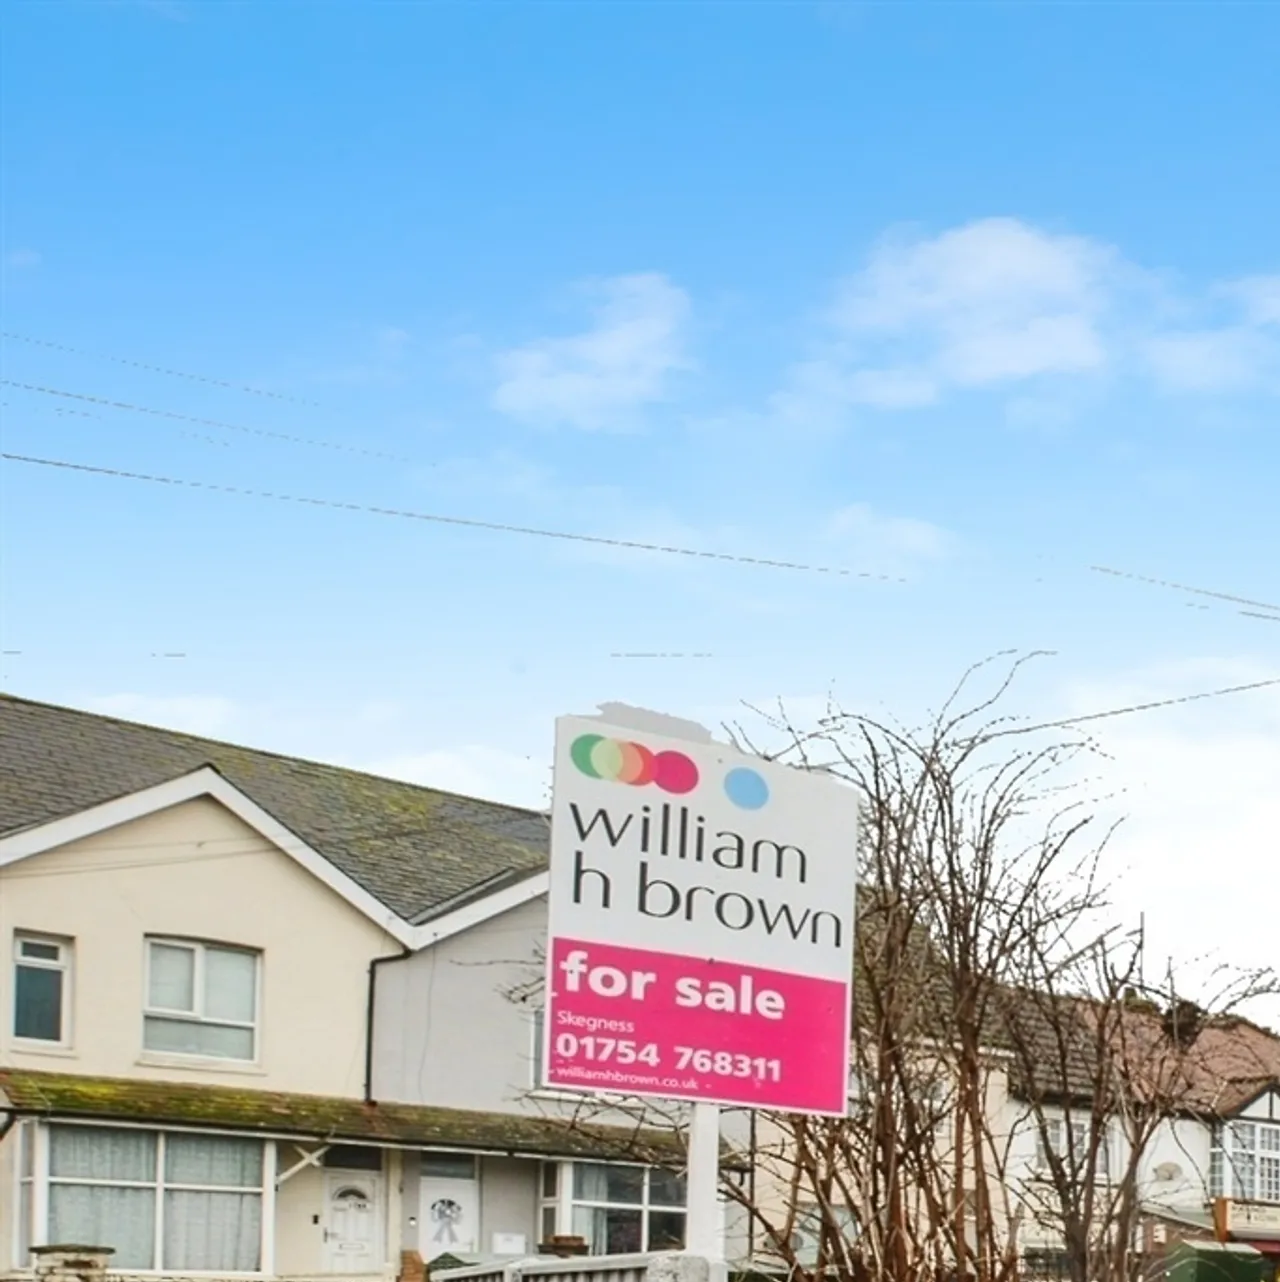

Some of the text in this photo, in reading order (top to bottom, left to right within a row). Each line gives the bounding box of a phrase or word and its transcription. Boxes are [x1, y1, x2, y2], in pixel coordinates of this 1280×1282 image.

[569, 802, 807, 883] william
[572, 850, 842, 948] h brown
[560, 950, 786, 1020] for sale
[556, 1010, 635, 1034] Skegness
[555, 1032, 781, 1082] 01754 768311
[556, 1066, 699, 1090] williamhbrown.co.uk
